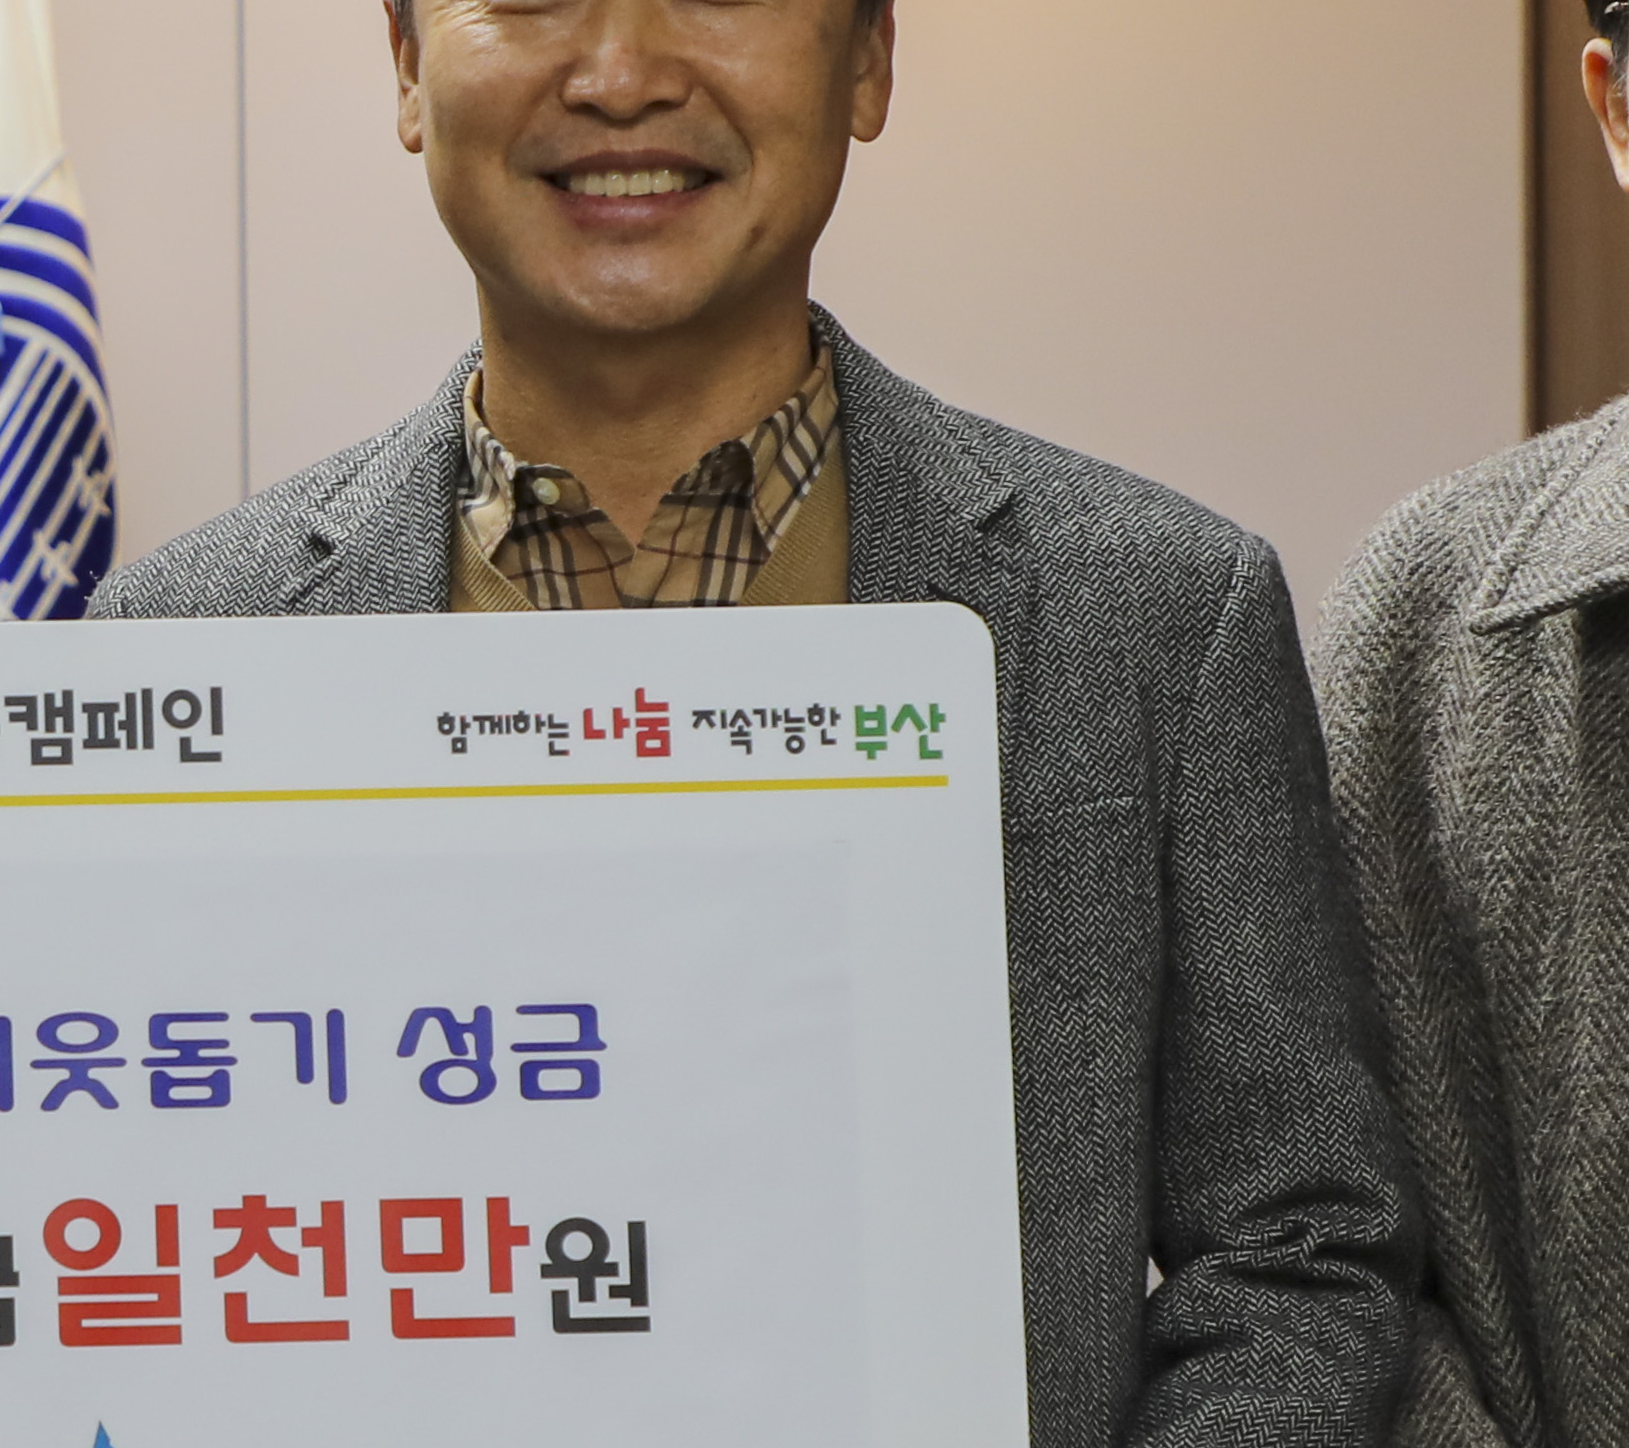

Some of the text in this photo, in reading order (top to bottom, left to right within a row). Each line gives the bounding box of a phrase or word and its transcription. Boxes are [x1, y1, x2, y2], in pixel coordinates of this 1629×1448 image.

[437, 687, 948, 761] 함께하는 나눔 지속가능한 부산
[396, 1003, 609, 1106] 성금
